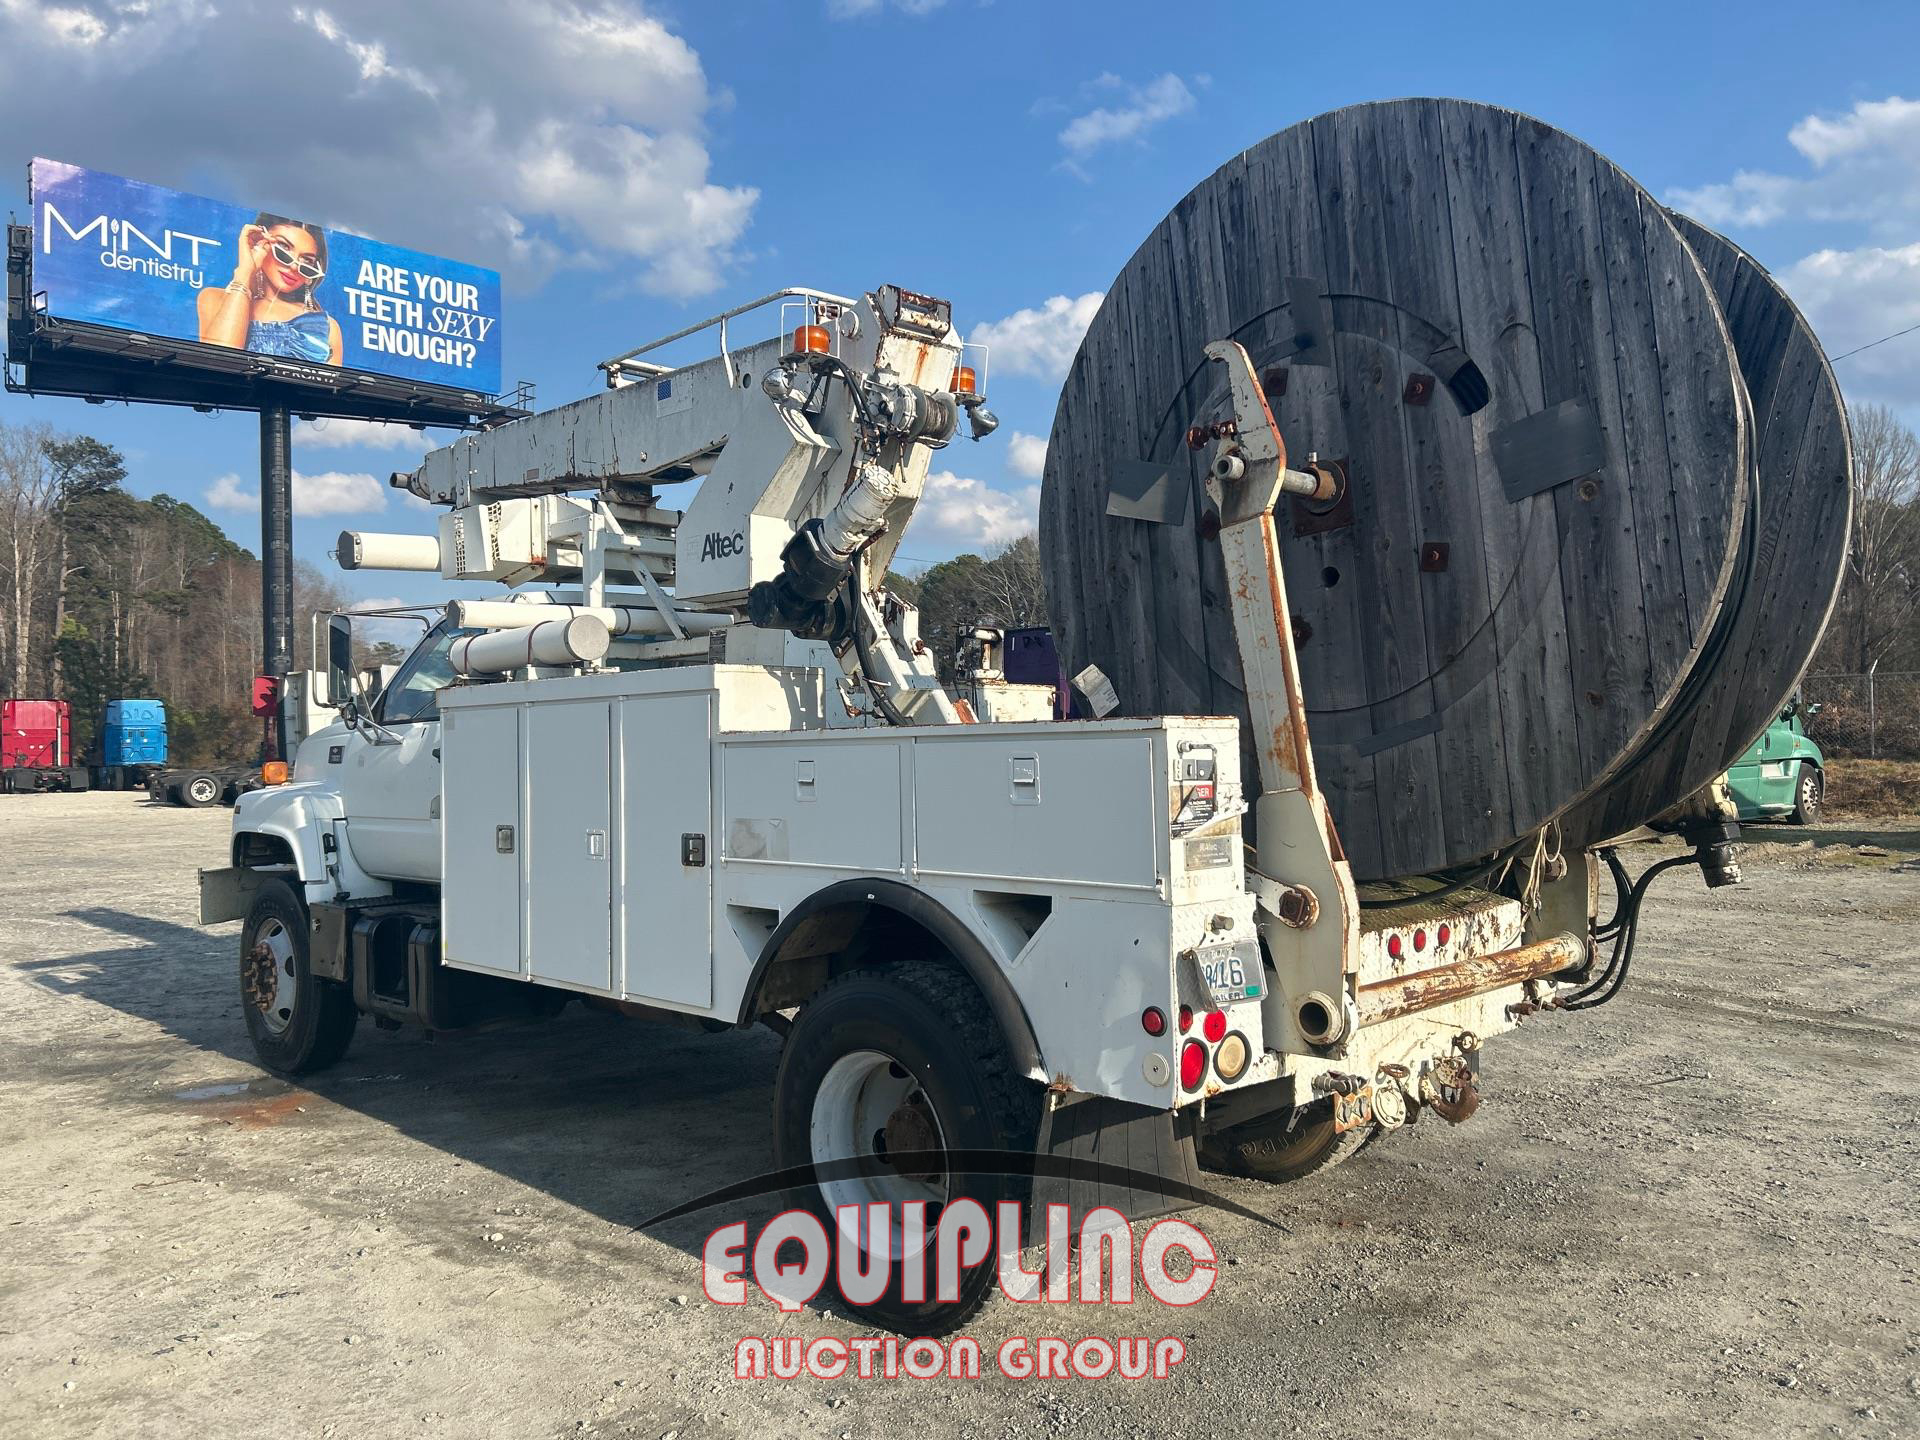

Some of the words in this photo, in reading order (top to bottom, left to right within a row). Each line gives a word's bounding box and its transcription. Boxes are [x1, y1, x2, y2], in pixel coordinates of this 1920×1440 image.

[100, 244, 204, 289] dentistry
[357, 259, 410, 296] ARE
[413, 271, 479, 312] YOUR
[343, 286, 423, 330] TEETH
[427, 306, 495, 342] SEXY
[362, 321, 477, 369] ENOUGH?
[701, 531, 744, 562] Altec
